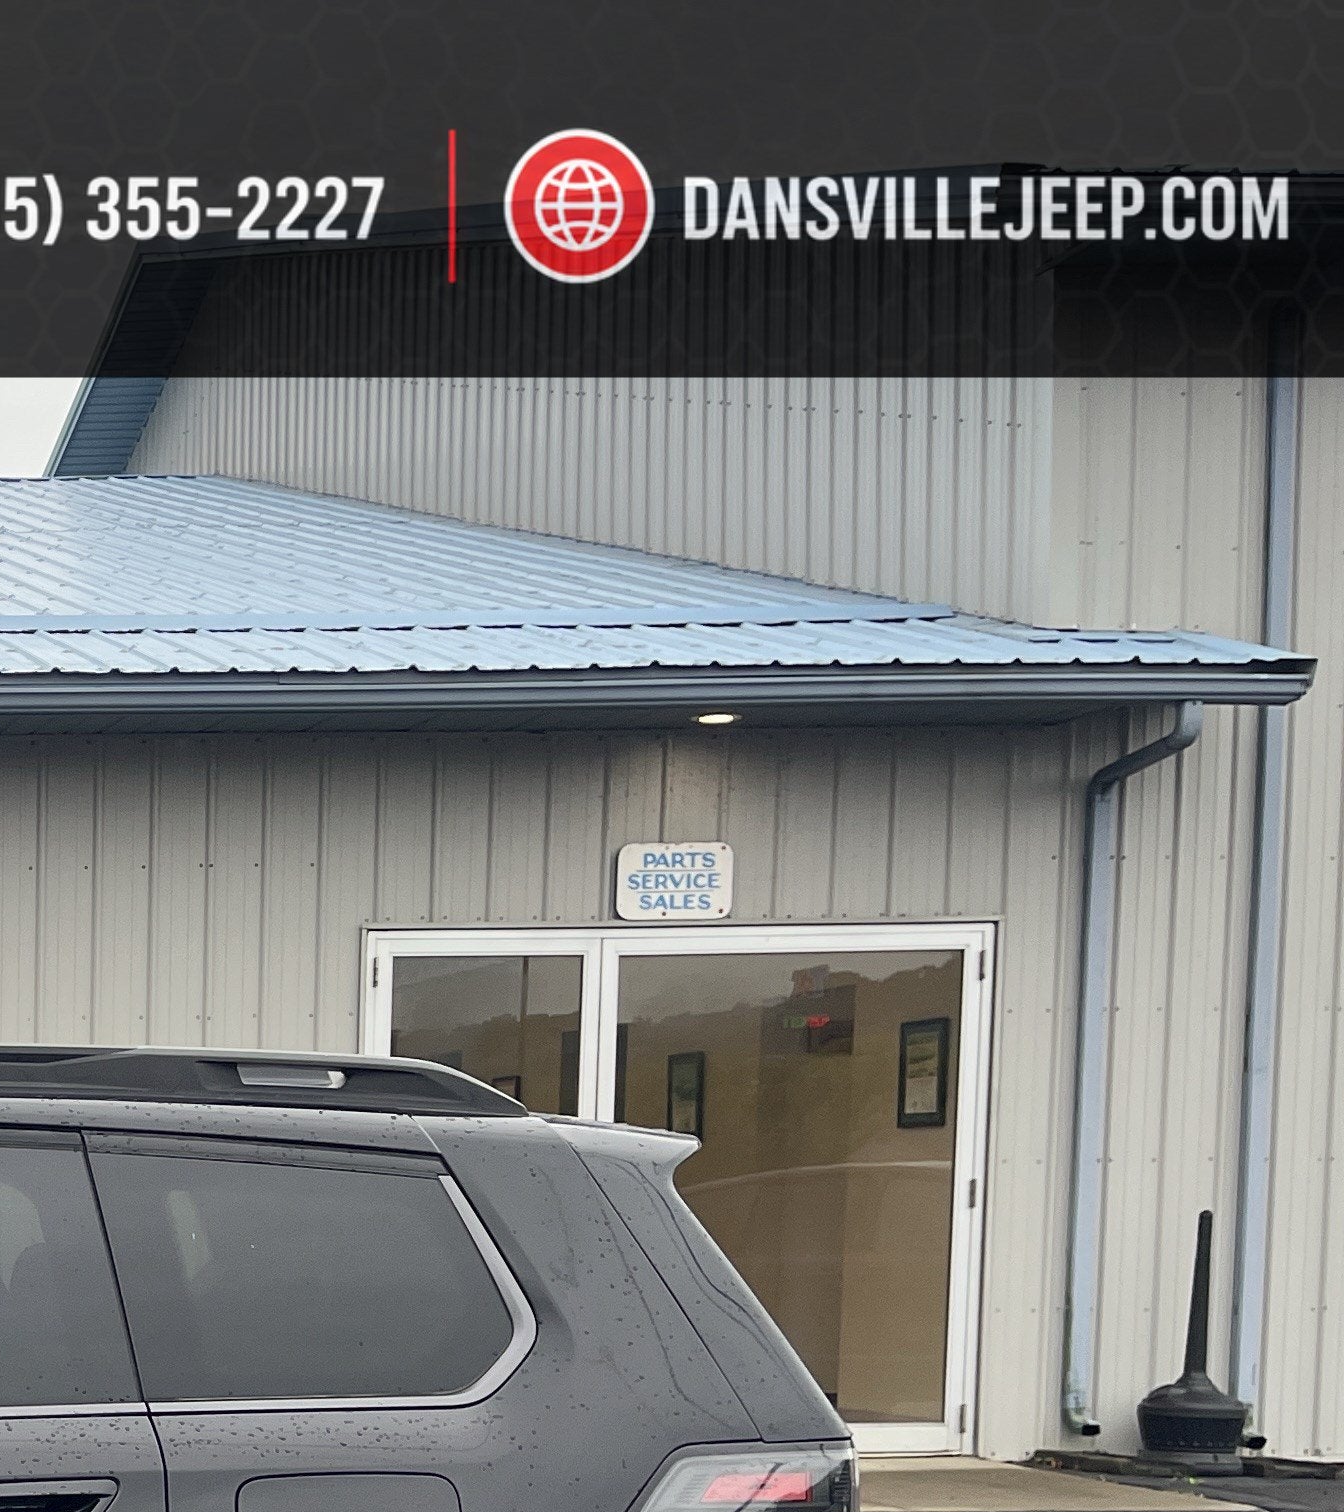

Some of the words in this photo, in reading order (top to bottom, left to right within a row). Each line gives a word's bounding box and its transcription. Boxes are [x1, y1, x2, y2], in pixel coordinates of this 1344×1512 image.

[643, 852, 716, 868] PARTS
[627, 873, 721, 890] SERVICE
[639, 894, 711, 910] SALES
